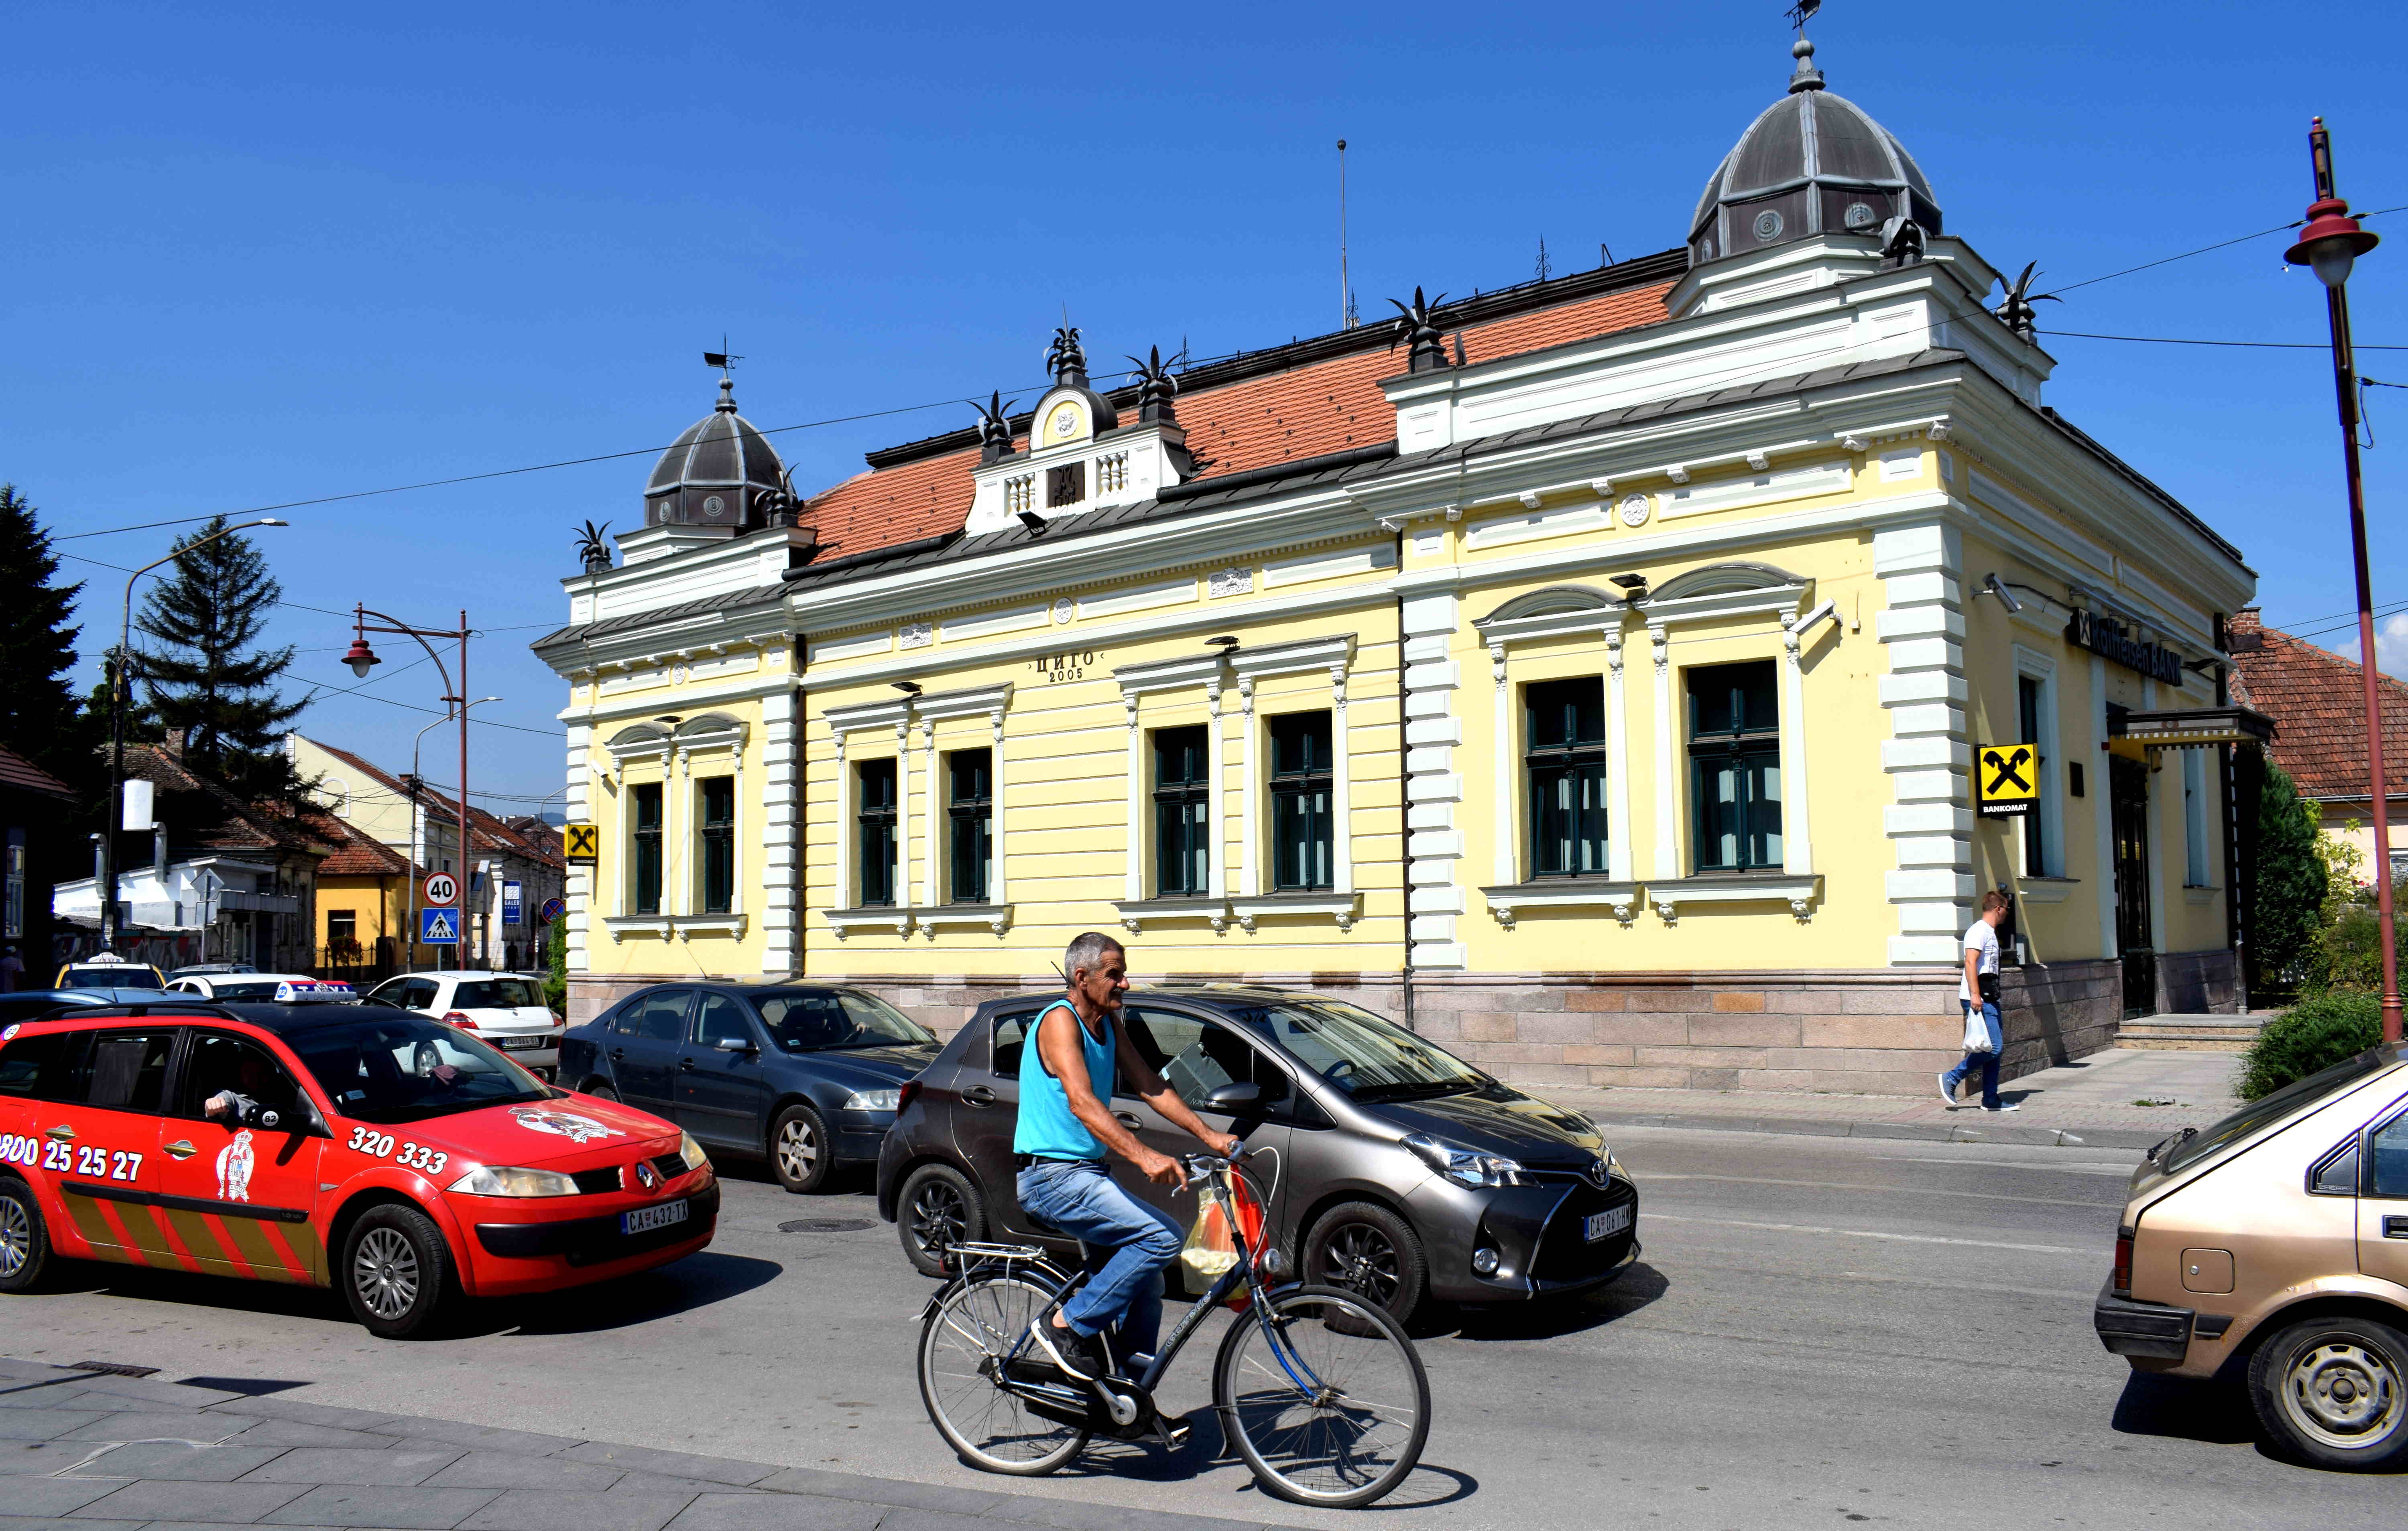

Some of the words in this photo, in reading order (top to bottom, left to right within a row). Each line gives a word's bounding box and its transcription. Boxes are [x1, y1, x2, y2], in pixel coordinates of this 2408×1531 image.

[2090, 613, 2151, 673] Raiffeisen
[2151, 643, 2182, 685] BANK
[1037, 651, 1094, 674] ЦИГО
[1049, 668, 1083, 682] 2005
[1983, 804, 2028, 812] BANKOMAT
[431, 881, 452, 898] 40
[297, 986, 351, 1000] TAXI
[0, 1133, 39, 1166] 800
[43, 1141, 73, 1172] 25
[77, 1145, 107, 1176] 25
[111, 1150, 143, 1182] 27
[348, 1126, 395, 1157] 320
[396, 1142, 448, 1175] 333
[1166, 1291, 1211, 1346] Gazelle
